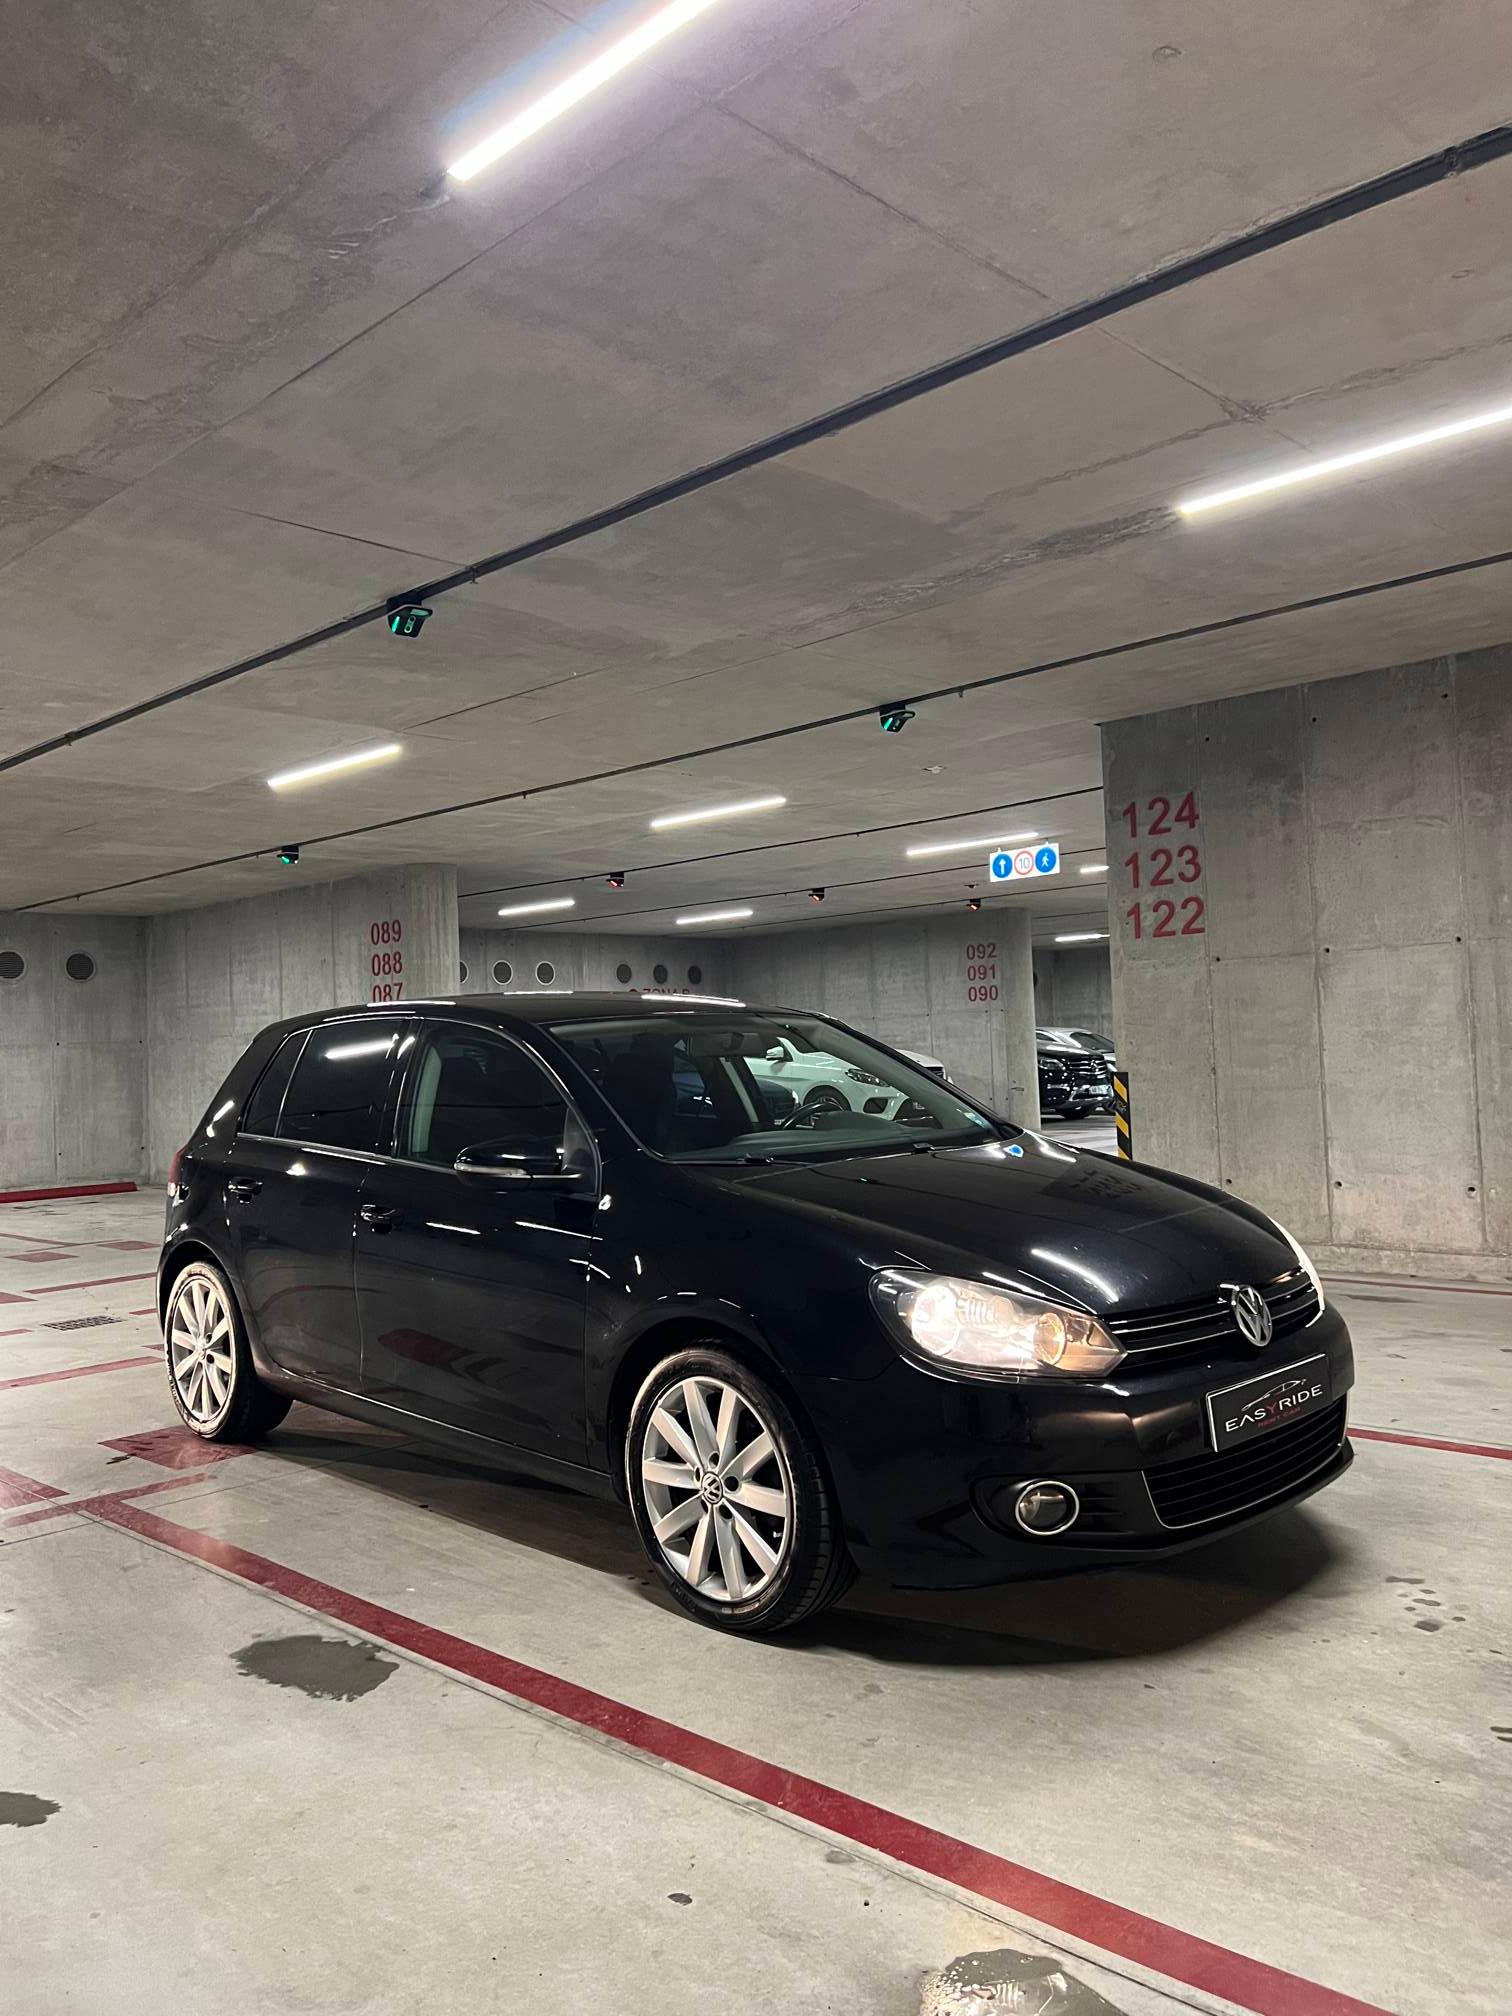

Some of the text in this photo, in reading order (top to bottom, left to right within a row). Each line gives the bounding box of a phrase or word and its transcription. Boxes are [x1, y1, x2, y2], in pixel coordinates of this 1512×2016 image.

[1122, 791, 1199, 838] 124
[1018, 857, 1030, 869] 10
[1124, 845, 1202, 889] 123
[1126, 896, 1206, 939] 122
[370, 920, 402, 945] 089
[371, 951, 403, 976] 088
[966, 943, 997, 960] 092
[967, 964, 996, 981] 091
[372, 981, 403, 1003] 087
[968, 985, 998, 1002] 090
[1225, 1384, 1323, 1432] EASYRIDE
